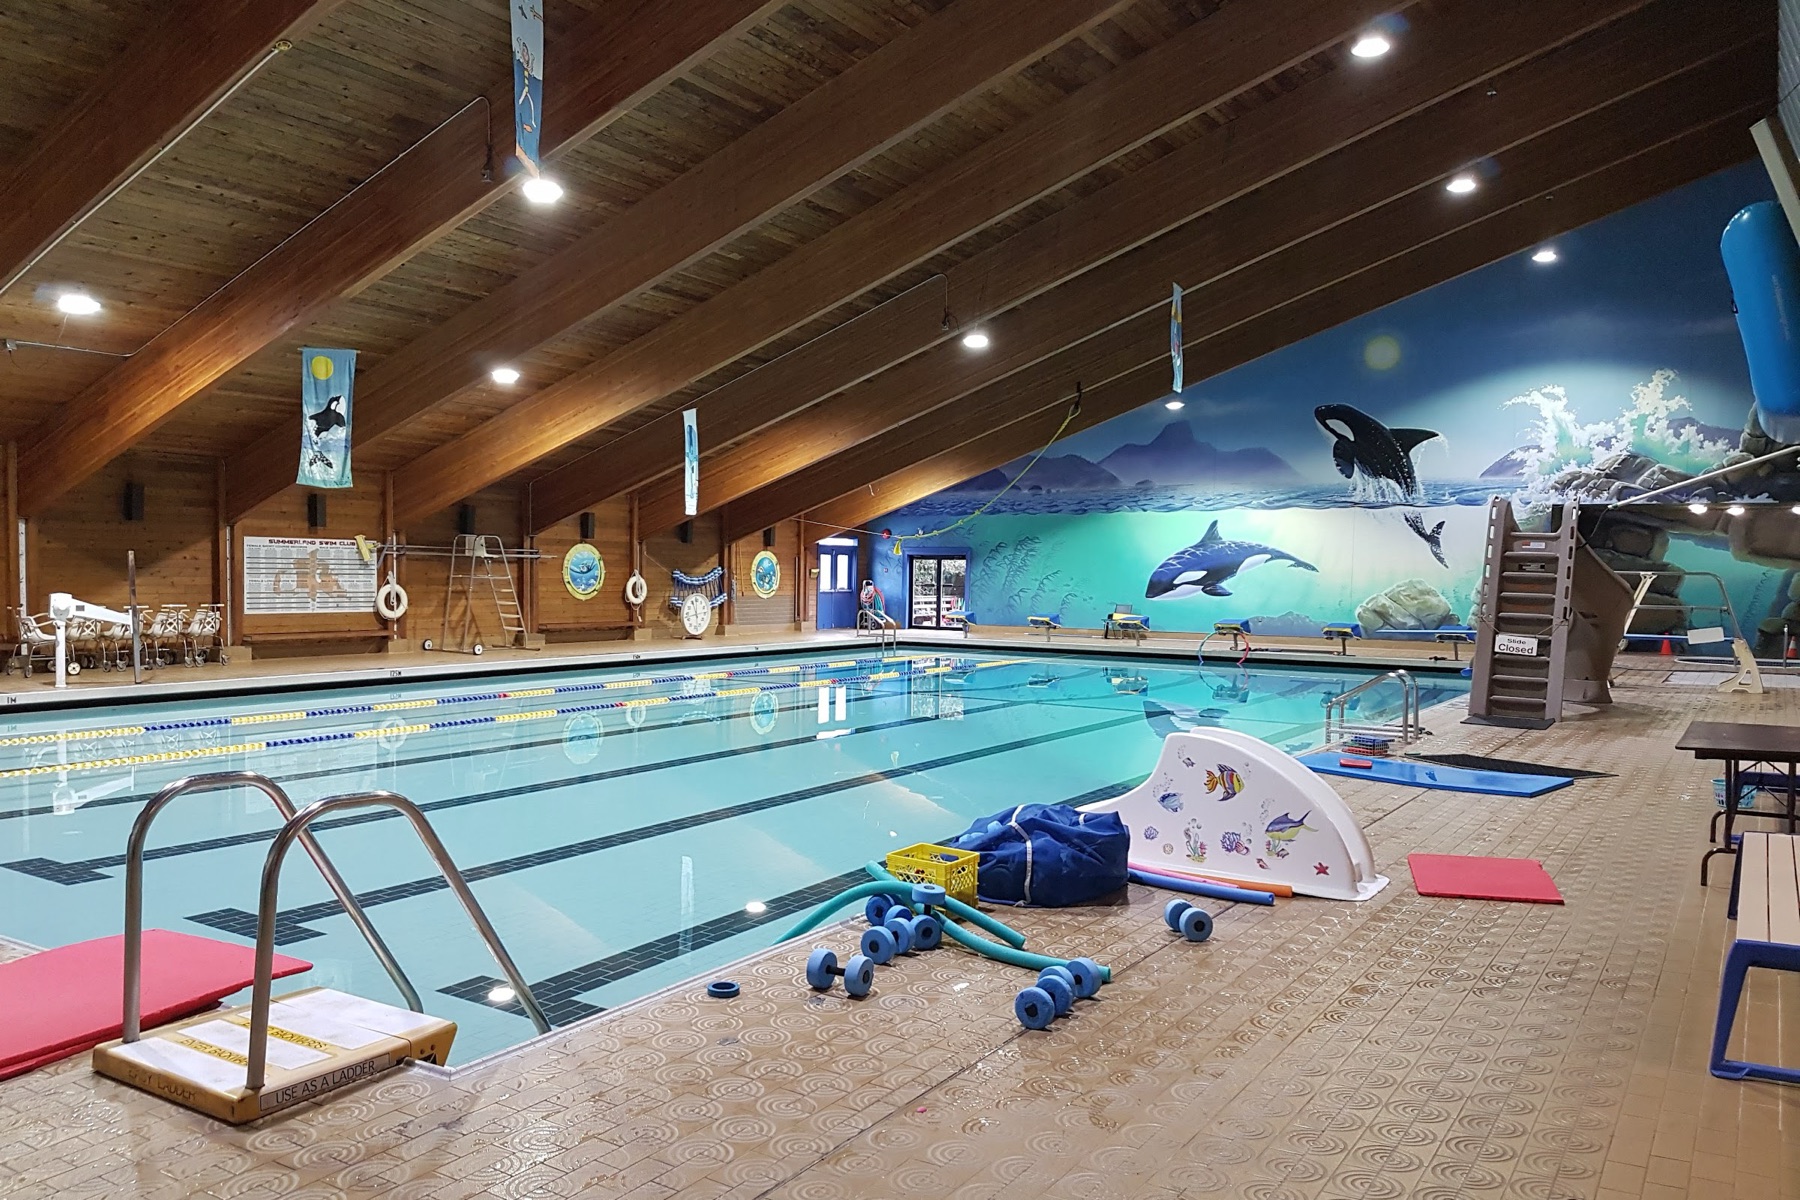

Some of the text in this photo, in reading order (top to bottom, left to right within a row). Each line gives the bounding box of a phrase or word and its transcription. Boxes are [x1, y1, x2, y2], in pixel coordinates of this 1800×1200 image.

[268, 538, 317, 546] SUMMERLAND
[1498, 643, 1534, 654] Closed
[275, 1060, 376, 1104] USE AS A LADDER
